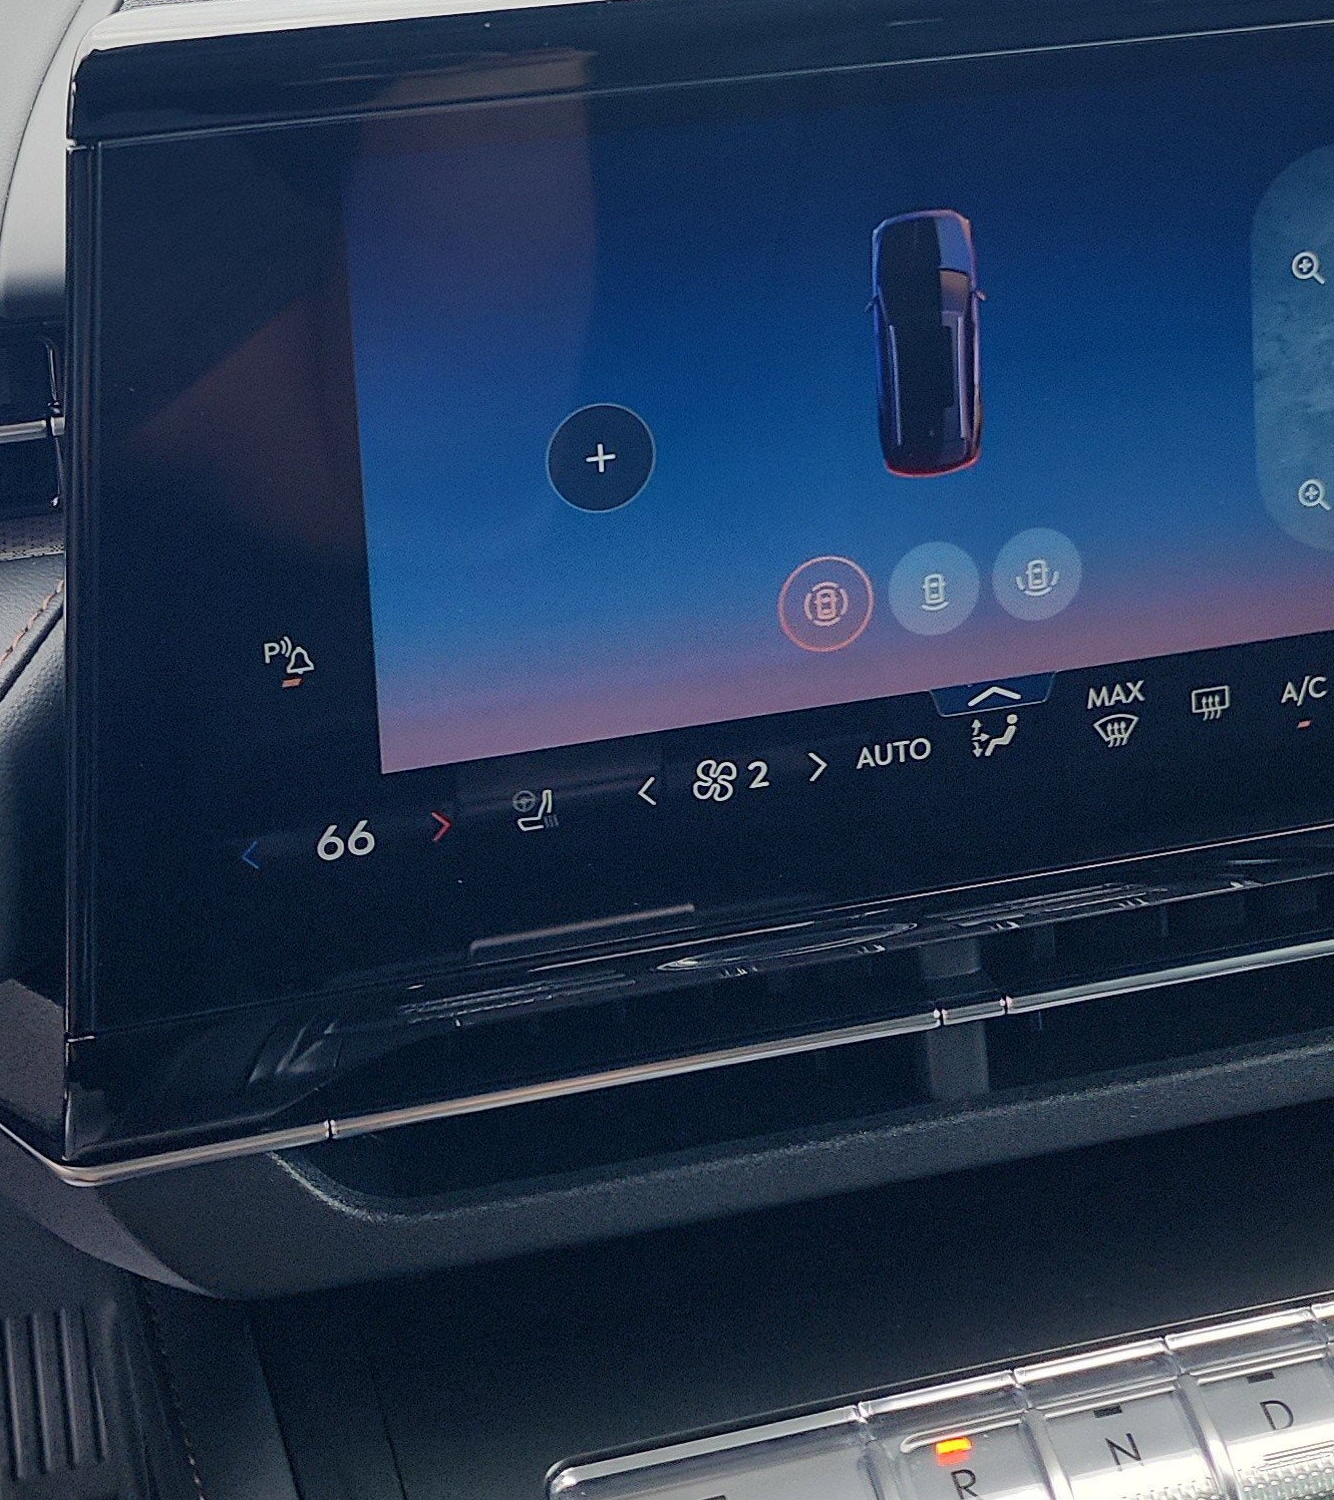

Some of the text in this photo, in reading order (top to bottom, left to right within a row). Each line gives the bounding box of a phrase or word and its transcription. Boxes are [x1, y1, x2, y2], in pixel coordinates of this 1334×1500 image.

[1087, 680, 1145, 709] MAX
[1281, 675, 1328, 704] A/C
[856, 737, 932, 769] AUTO
[747, 760, 769, 790] 2
[317, 819, 375, 861] 66
[1105, 1432, 1145, 1472] N
[1260, 1400, 1295, 1432] D
